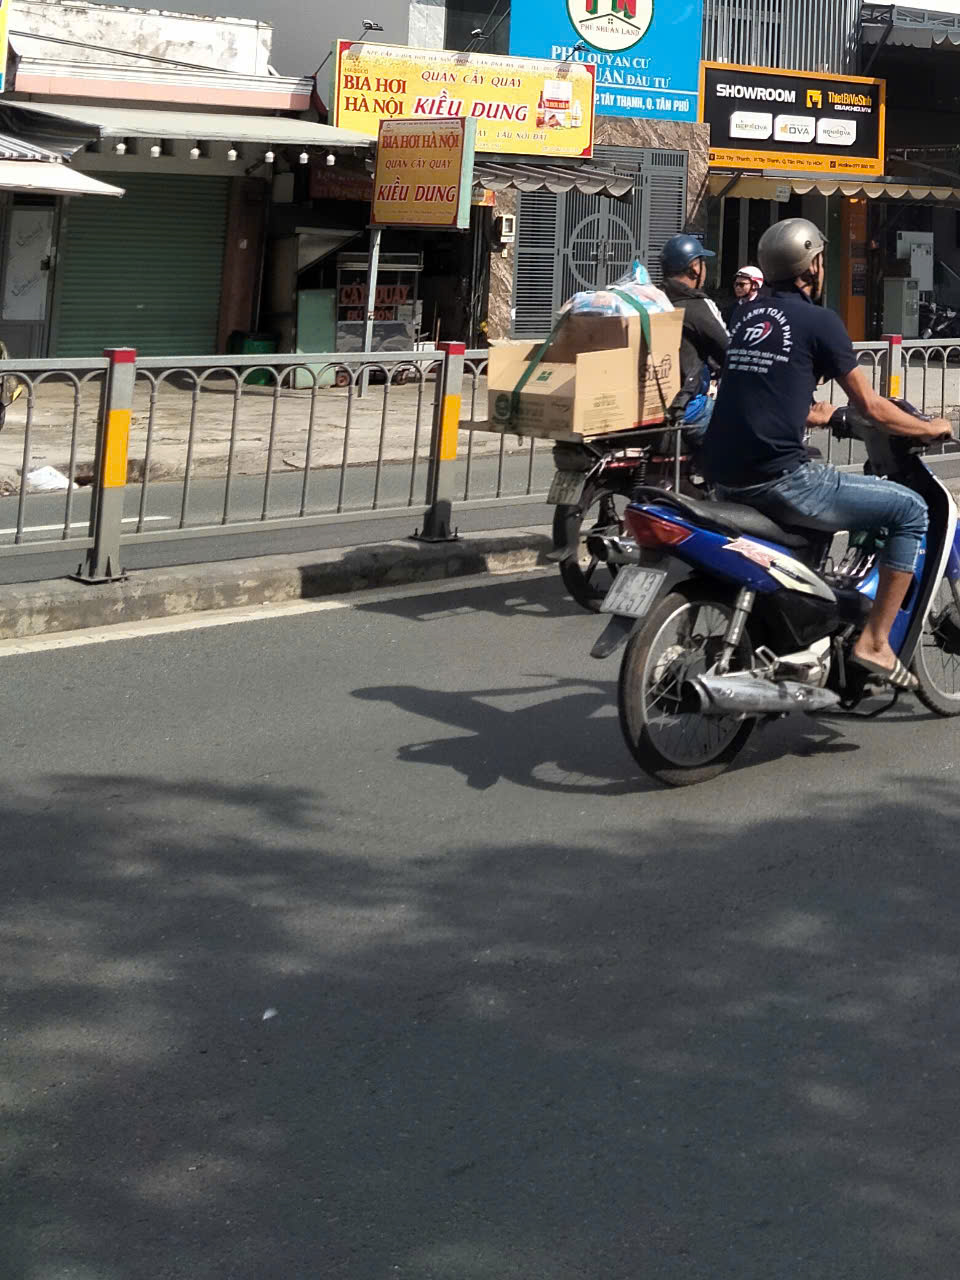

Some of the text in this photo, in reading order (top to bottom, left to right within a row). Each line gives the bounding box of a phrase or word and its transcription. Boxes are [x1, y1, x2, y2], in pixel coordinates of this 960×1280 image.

[614, 56, 631, 68] AN
[632, 57, 652, 69] CƯ
[343, 75, 407, 94] BIA HƠI
[491, 76, 521, 88] QUAY
[653, 76, 672, 89] TƯ
[600, 93, 615, 106] TÂY
[655, 97, 671, 111] TÂN
[673, 98, 690, 112] PHÚ
[716, 83, 796, 103] SHOWROOM
[344, 94, 404, 119] HÀ NỘI
[413, 89, 528, 121] KIỀU DUNG
[382, 130, 460, 151] BIA HƠI HÀ NỘI
[429, 159, 453, 170] QUAY
[377, 176, 409, 202] KIỀU
[413, 185, 457, 204] DUNG
[743, 327, 763, 341] TP
[781, 324, 793, 353] PHÁT
